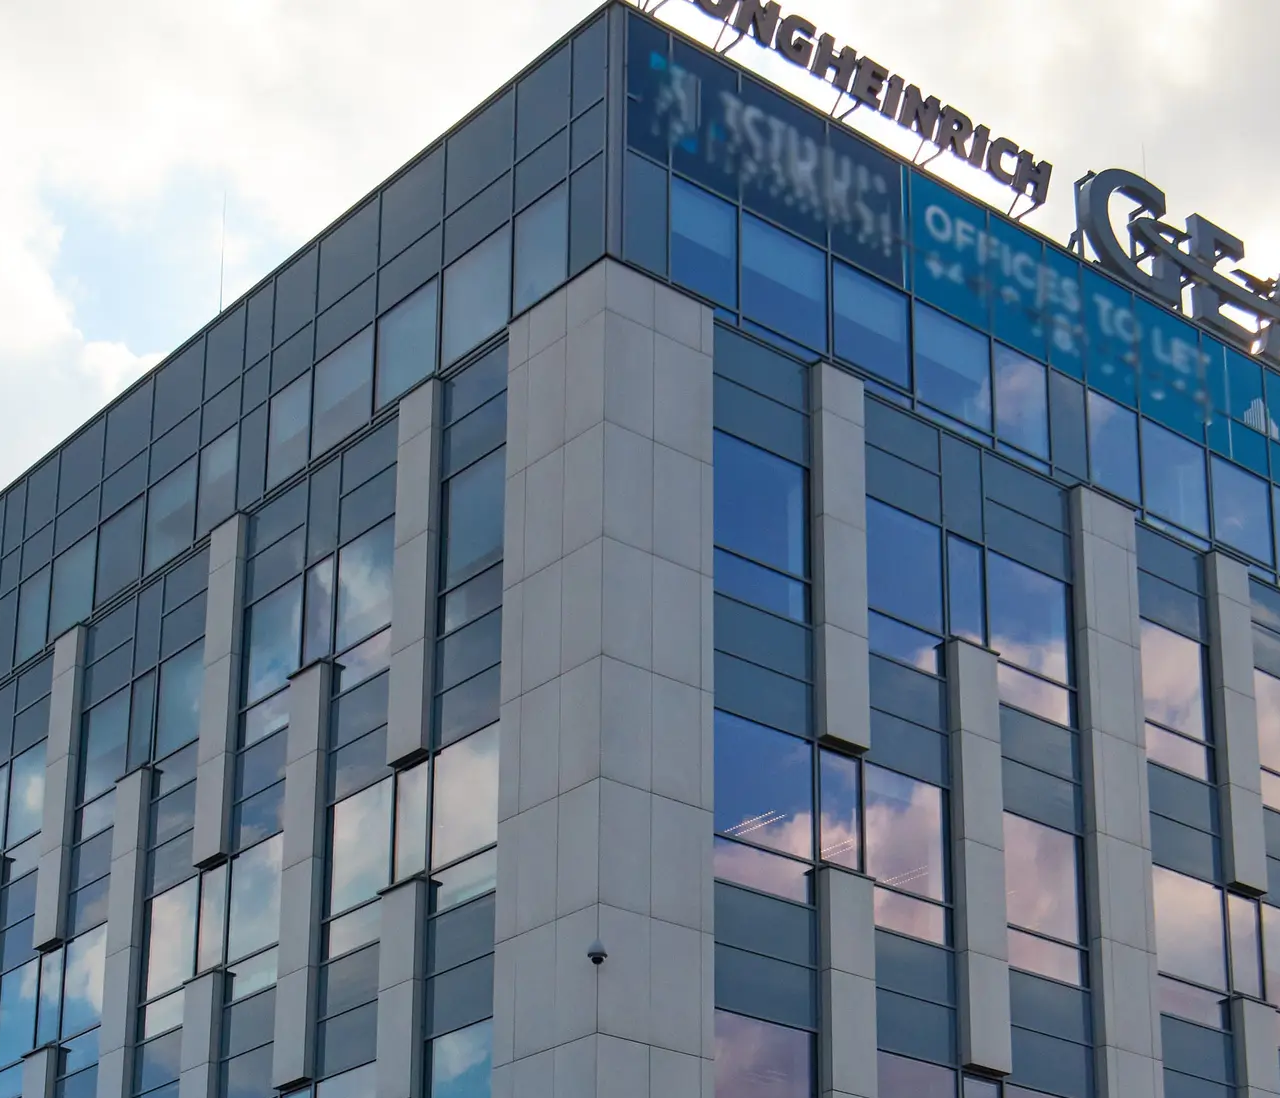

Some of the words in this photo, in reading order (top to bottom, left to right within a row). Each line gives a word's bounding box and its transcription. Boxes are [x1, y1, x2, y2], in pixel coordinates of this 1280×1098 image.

[925, 203, 1080, 313] OFFICES
[1090, 290, 1143, 344] TO
[1151, 324, 1211, 375] LET
